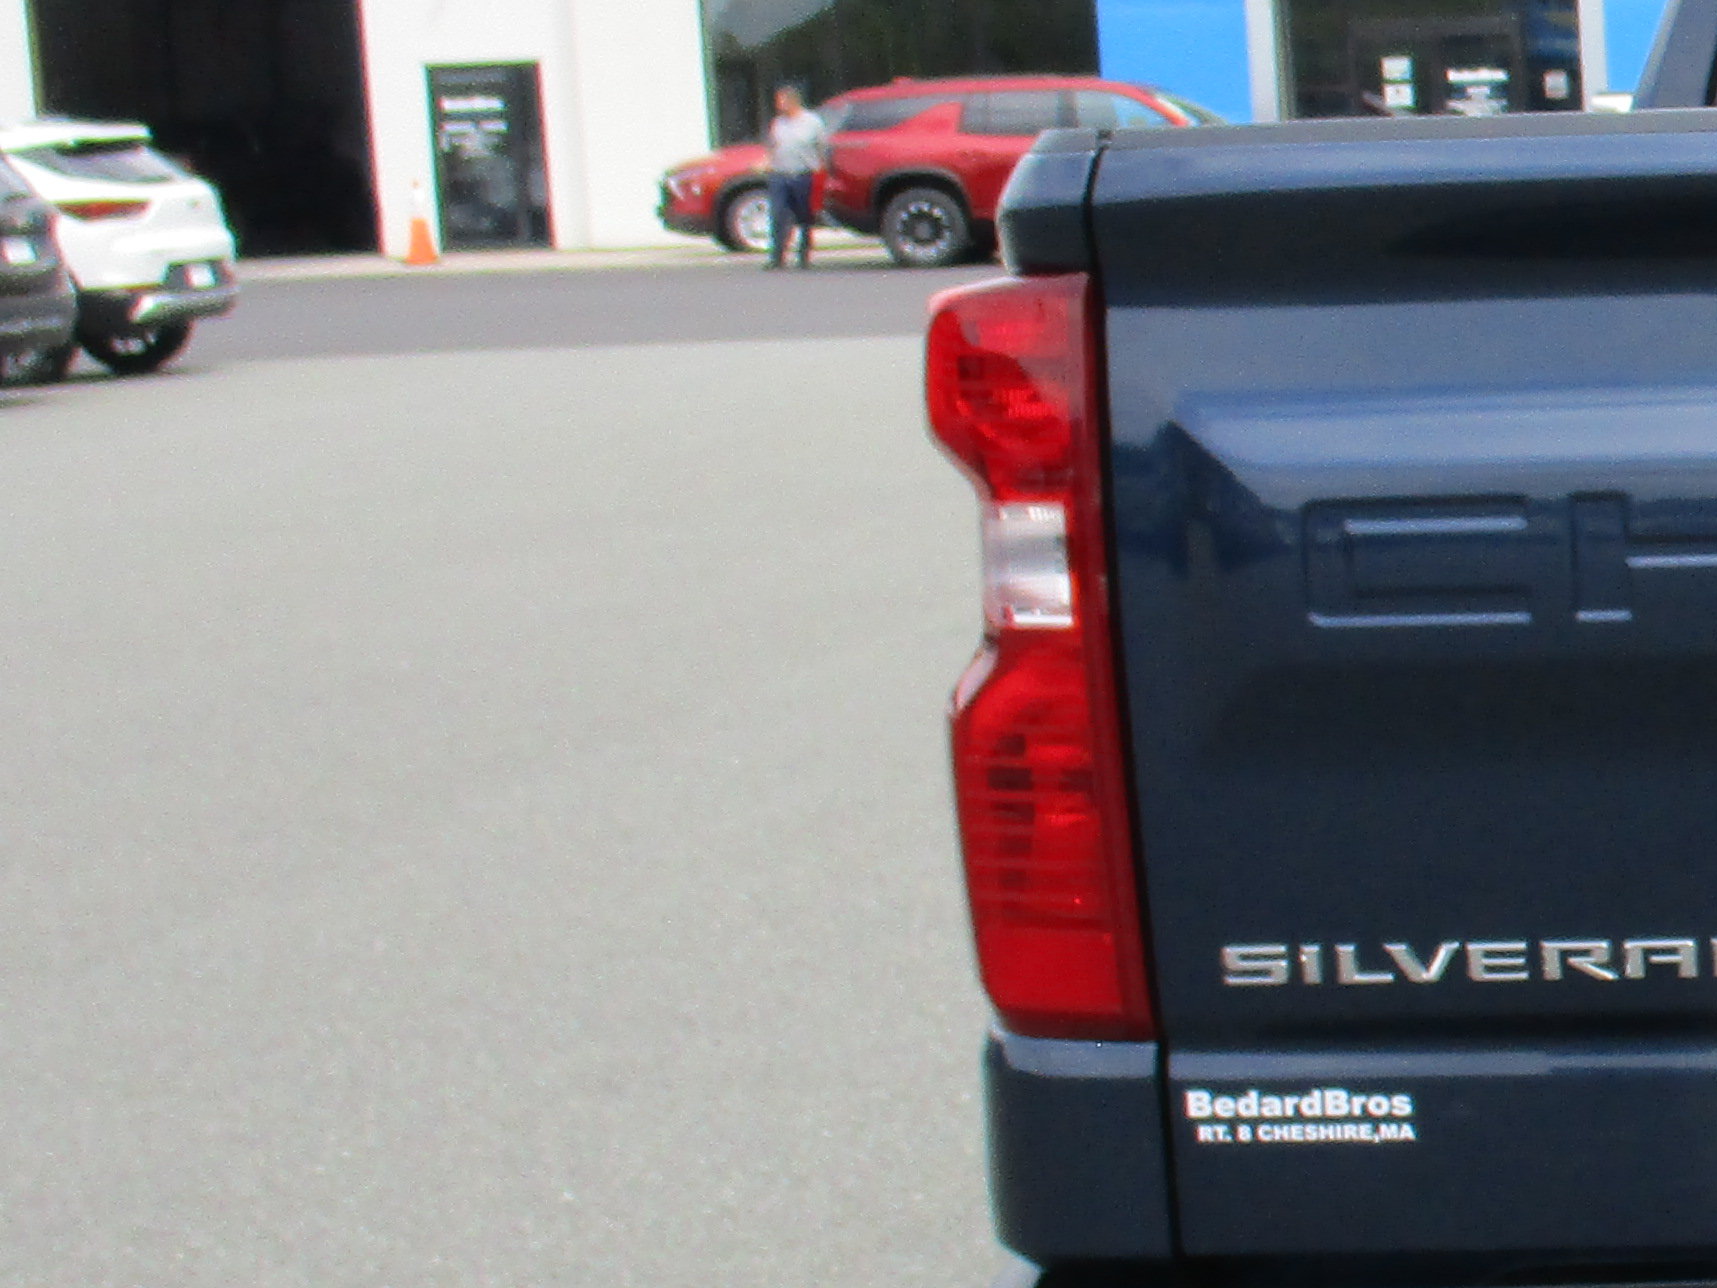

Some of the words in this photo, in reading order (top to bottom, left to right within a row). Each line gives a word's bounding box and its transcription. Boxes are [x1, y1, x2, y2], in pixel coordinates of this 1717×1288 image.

[1185, 1088, 1413, 1119] BedardBros
[1198, 1124, 1233, 1142] RT.
[1236, 1124, 1253, 1141] 8
